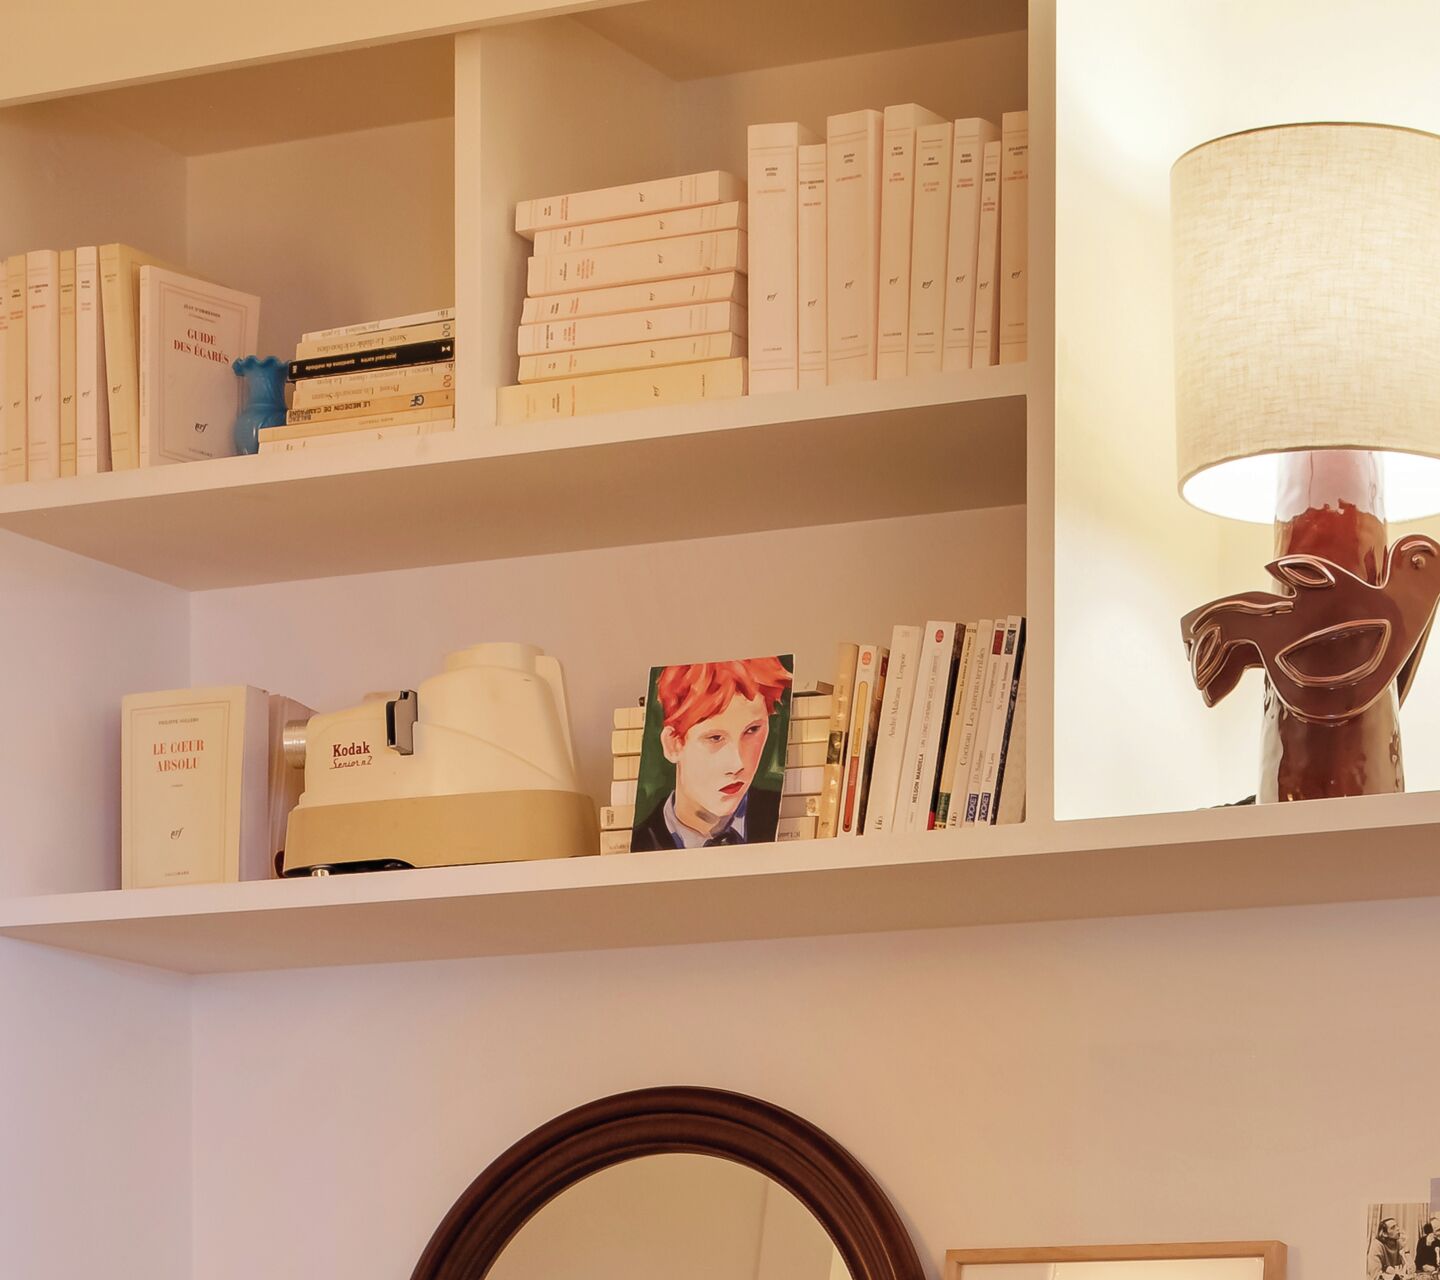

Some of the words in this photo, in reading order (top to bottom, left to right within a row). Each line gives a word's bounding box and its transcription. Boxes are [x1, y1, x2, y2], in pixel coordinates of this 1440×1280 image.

[187, 328, 217, 346] GUIDE
[173, 339, 192, 353] DES
[193, 343, 230, 365] ÉGARÉS
[153, 743, 167, 756] LE
[332, 741, 371, 758] Kodak
[157, 757, 200, 772] ABSOLU
[916, 753, 924, 780] MANDELA
[912, 781, 921, 804] NELSON
